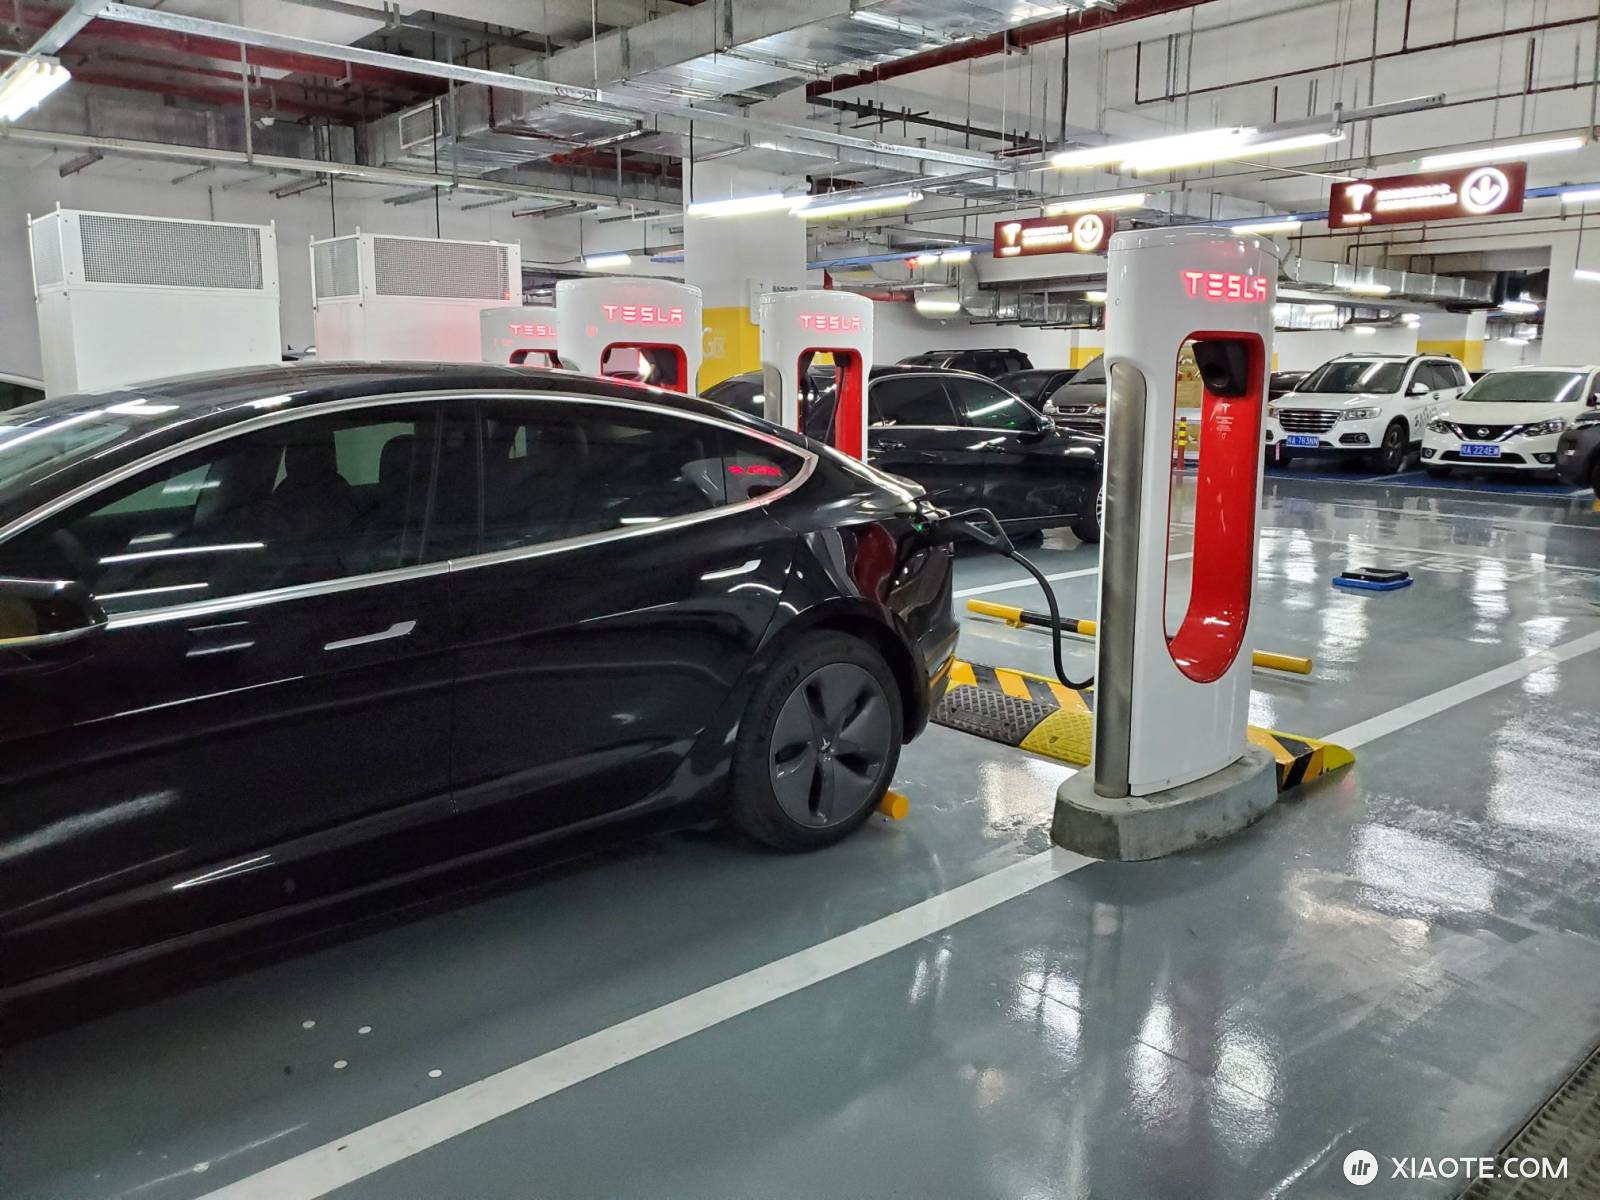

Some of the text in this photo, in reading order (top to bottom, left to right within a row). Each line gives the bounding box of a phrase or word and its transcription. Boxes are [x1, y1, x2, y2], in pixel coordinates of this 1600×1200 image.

[1185, 271, 1267, 300] TESLA
[603, 305, 683, 322] TESLA
[800, 315, 861, 329] TESLA
[510, 324, 557, 336] TESL
